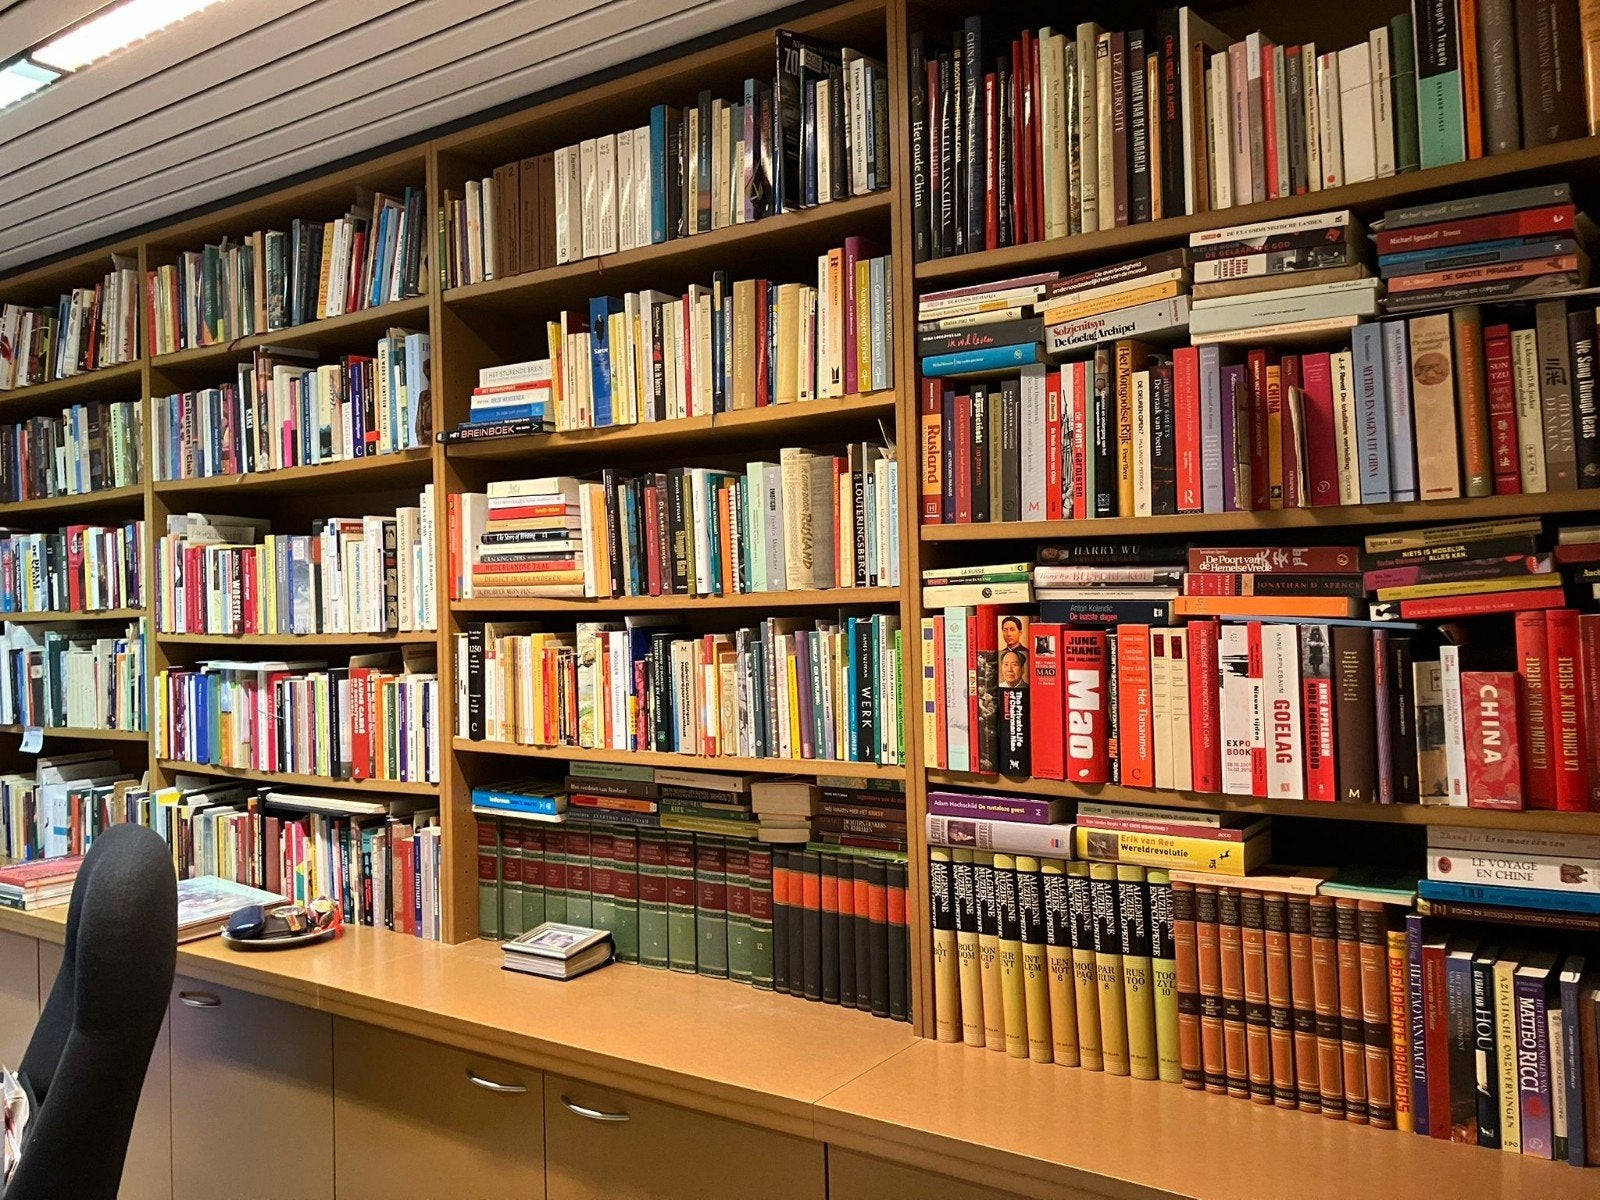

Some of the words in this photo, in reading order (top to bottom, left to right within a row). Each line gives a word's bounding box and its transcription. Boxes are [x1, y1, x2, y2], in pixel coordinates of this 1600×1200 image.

[1435, 0, 1446, 32] eople's
[966, 32, 975, 65] CHINA
[1130, 40, 1143, 50] DE
[1438, 33, 1447, 66] Tragedy
[1113, 52, 1122, 66] DE
[1494, 53, 1503, 64] de
[967, 78, 975, 92] DE
[1131, 70, 1143, 101] DROMEN
[1493, 66, 1506, 111] bevrijding
[1113, 70, 1124, 133] ZIJDEROUTE
[1132, 102, 1144, 118] VAN
[913, 121, 924, 142] Het
[1133, 119, 1144, 128] DE
[913, 144, 924, 171] oude
[968, 133, 976, 164] MARS
[1134, 130, 1145, 173] MANDARIJN
[914, 173, 924, 208] China
[1299, 219, 1323, 228] LANDEN
[321, 260, 330, 283] OPEN
[1455, 270, 1483, 279] GROTE
[1486, 265, 1523, 275] PIRAMIDE
[319, 285, 327, 306] STAD
[1053, 318, 1105, 338] Solzjenitsyn
[1054, 337, 1067, 348] De
[1067, 331, 1098, 346] Goelag
[1098, 322, 1136, 341] Archipel
[1119, 348, 1130, 366] Het
[1575, 340, 1589, 354] We
[1575, 356, 1592, 378] Sang
[1137, 381, 1143, 389] DE
[1154, 379, 1162, 390] De
[1363, 365, 1374, 398] MYTHEN
[1118, 367, 1130, 423] Mongoolse
[1154, 391, 1162, 414] wraak
[1268, 383, 1280, 414] CHINA
[1341, 392, 1347, 402] De
[1365, 400, 1375, 411] EN
[1578, 379, 1594, 414] Through
[1075, 412, 1083, 420] de
[1366, 412, 1376, 437] SAGEN
[460, 425, 515, 439] BREINBOEK
[1120, 424, 1131, 445] Rijk
[1582, 416, 1596, 439] Tears
[927, 424, 941, 484] Rusland
[1155, 432, 1163, 456] Poetin
[1342, 437, 1350, 470] verleiding
[1368, 438, 1377, 451] UIT
[1368, 453, 1378, 478] CHINA
[855, 483, 866, 576] LOUTERINGSBERG
[801, 513, 813, 570] RUSLAND
[1073, 545, 1115, 556] HARRY
[1119, 544, 1141, 555] WU
[1402, 548, 1423, 557] NIETS
[485, 563, 533, 571] NEDERLANDSE
[534, 562, 550, 570] TAAL
[1199, 562, 1210, 570] de
[1211, 563, 1247, 572] Hemelse
[1247, 564, 1272, 572] Vrede
[1206, 556, 1218, 564] De
[1219, 556, 1243, 566] Poort
[1429, 553, 1450, 561] ALLES
[232, 579, 241, 621] WOESTEN
[1069, 613, 1078, 621] De
[1079, 613, 1099, 621] laatste
[1100, 613, 1118, 622] dagen
[469, 645, 481, 653] 1250
[1066, 646, 1101, 655] CHANG
[1068, 637, 1097, 646] JUNG
[1036, 668, 1056, 676] MAO
[1010, 691, 1015, 699] of
[1137, 688, 1147, 704] Het
[1308, 683, 1317, 705] RODE
[1319, 683, 1328, 705] ANNE
[861, 687, 872, 729] WERK
[1067, 669, 1100, 759] Mao
[1274, 700, 1292, 764] GOELAG
[1320, 706, 1330, 757] APPLEBAUM
[1479, 684, 1502, 764] CHINA
[1308, 707, 1319, 770] HONGERSNOOD
[1120, 843, 1189, 857] Wereldrevolutie
[1121, 835, 1139, 844] Erik
[1141, 837, 1156, 845] van
[1158, 838, 1175, 847] Ree
[1472, 857, 1484, 867] LE
[1489, 859, 1538, 871] VOYAGE
[1476, 869, 1492, 878] EN
[1495, 870, 1534, 881] CHINE
[1125, 884, 1135, 921] MUZIEK
[1133, 885, 1144, 937] ALGEMENE
[1118, 883, 1129, 953] ENCYCLOPEDIE
[1051, 958, 1069, 967] LEN
[1051, 966, 1070, 975] MOT
[1126, 968, 1144, 977] RUS
[1126, 976, 1146, 986] TOO
[1156, 971, 1176, 980] TOO
[1156, 979, 1176, 988] ZYL
[1410, 963, 1422, 987] HET
[1161, 987, 1171, 996] 10
[1390, 957, 1406, 1040] DECADENTE
[1500, 976, 1512, 1040] AZIATISCHE
[1412, 1016, 1423, 1039] VAN
[1475, 1009, 1493, 1050] HOU
[1519, 997, 1537, 1048] MATTEO
[1414, 1039, 1426, 1082] MACHT
[1519, 1049, 1538, 1093] RICCI
[1395, 1045, 1410, 1113] DROMERS
[1503, 1044, 1515, 1128] OMZWERVINGEN
